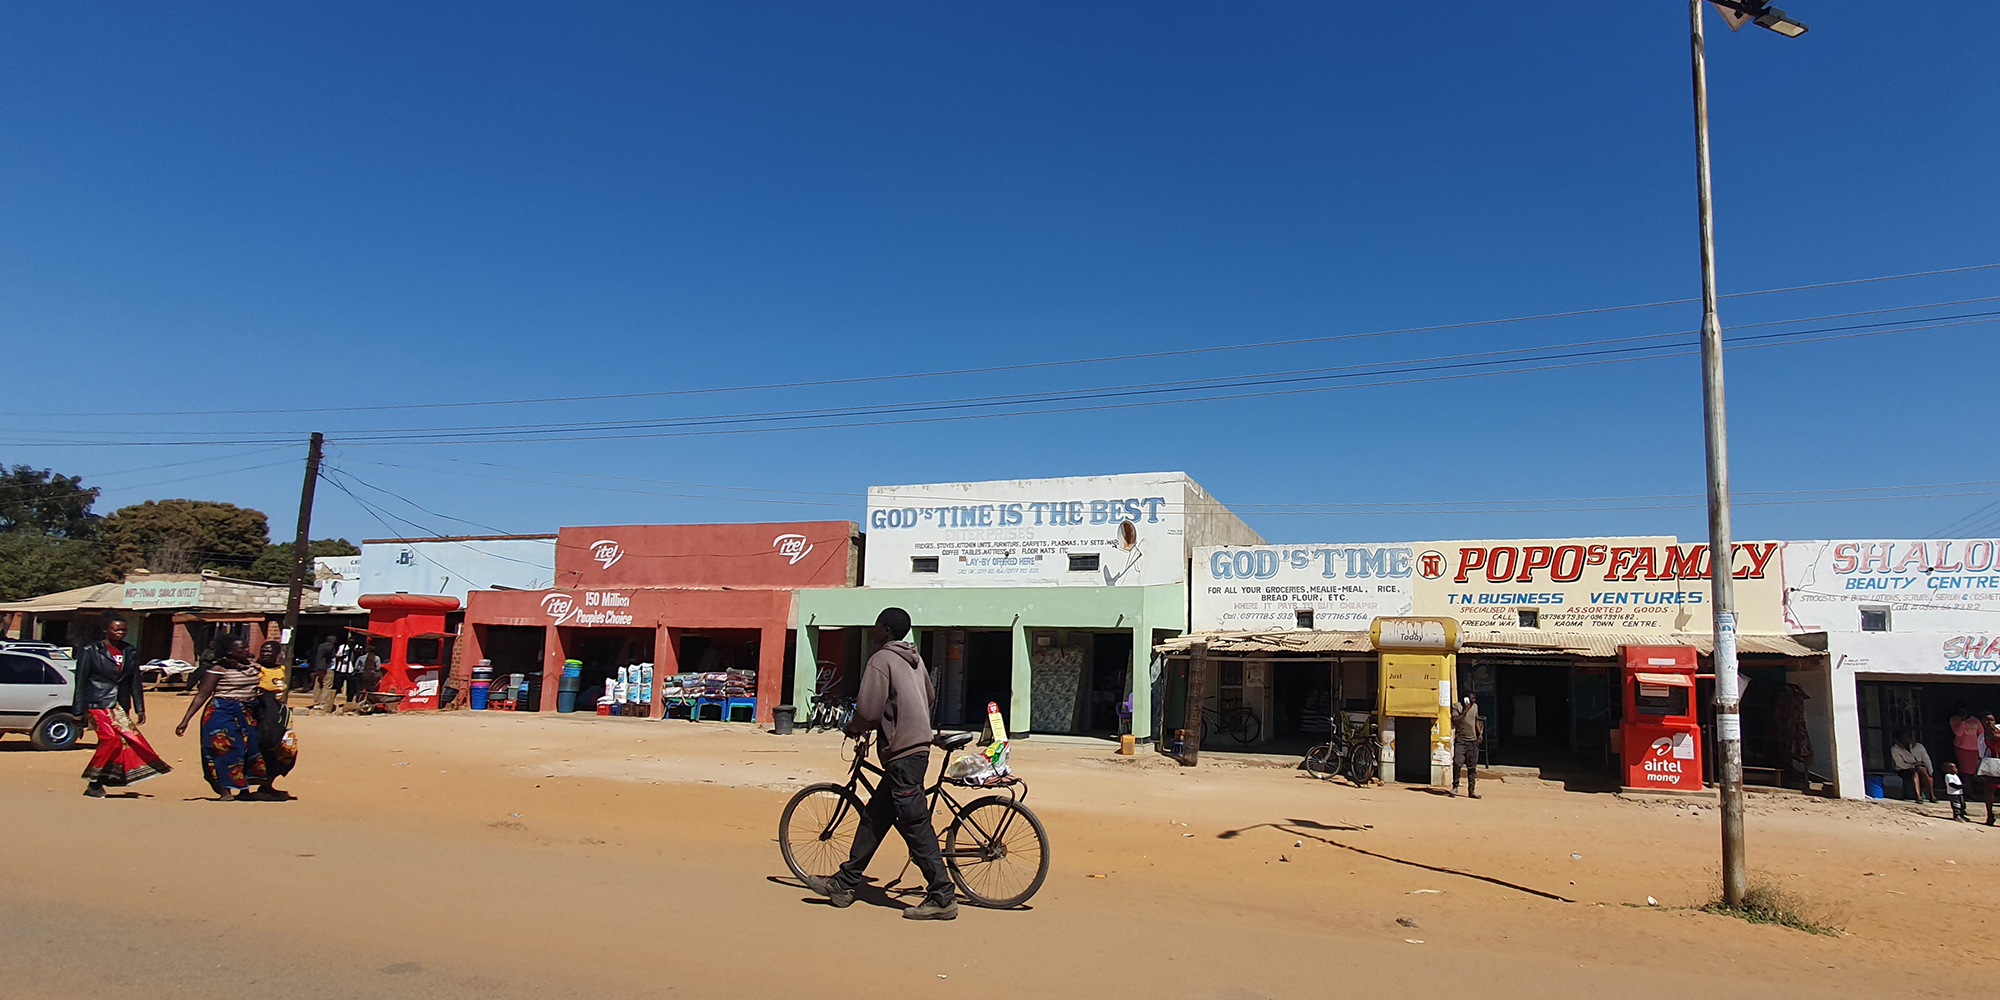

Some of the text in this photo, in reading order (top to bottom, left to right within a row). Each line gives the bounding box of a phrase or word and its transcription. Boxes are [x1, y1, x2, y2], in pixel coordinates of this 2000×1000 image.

[871, 508, 933, 529] GOD'S
[935, 505, 992, 528] TIME
[997, 503, 1023, 526] IS
[1028, 500, 1084, 526] THE
[945, 527, 1034, 542] ENTERPRISES
[966, 556, 1035, 566] LAY-BY OFFERED HERE
[1210, 547, 1413, 580] GOD'S TIME
[1832, 540, 2000, 574] SHALO
[1844, 575, 2000, 591] BEAUTY CENTRE
[1207, 586, 1222, 595] FOR
[1224, 586, 1238, 594] ALL
[1241, 586, 1262, 594] YOUR
[1961, 593, 1969, 601] &
[1969, 592, 2000, 601] COSMET
[585, 591, 630, 607] 150 Million
[1261, 594, 1288, 602] BREAD
[1233, 602, 1258, 610] WHERE
[1459, 606, 1506, 614] SPECIALISED
[1566, 606, 1623, 614] ASSORTED
[605, 609, 633, 625] Choice
[1400, 632, 1424, 643] Today
[1643, 757, 1683, 774] airtel
[1646, 773, 1681, 785] money
